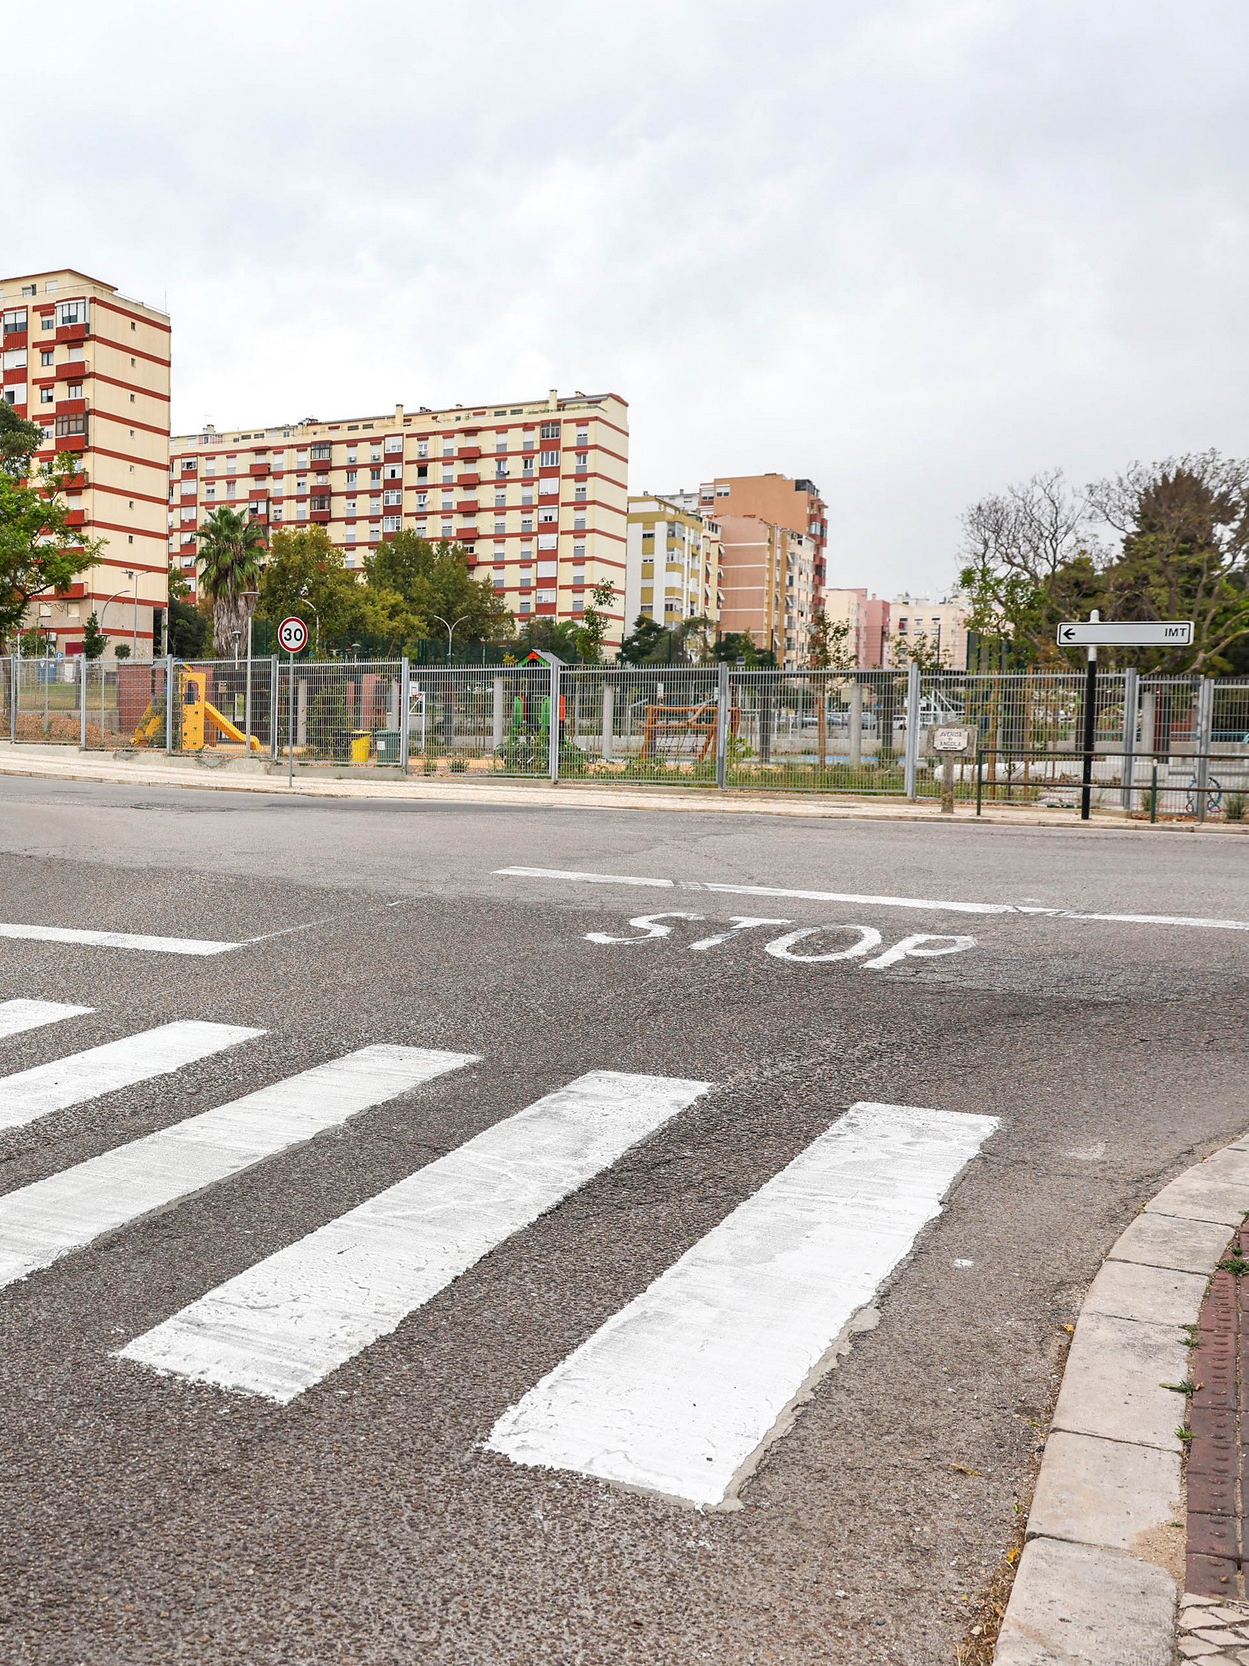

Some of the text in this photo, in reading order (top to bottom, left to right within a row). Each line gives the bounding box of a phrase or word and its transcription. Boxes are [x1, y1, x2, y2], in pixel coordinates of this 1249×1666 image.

[283, 628, 303, 642] 30
[1164, 627, 1187, 637] IMT
[583, 912, 978, 970] STOP
